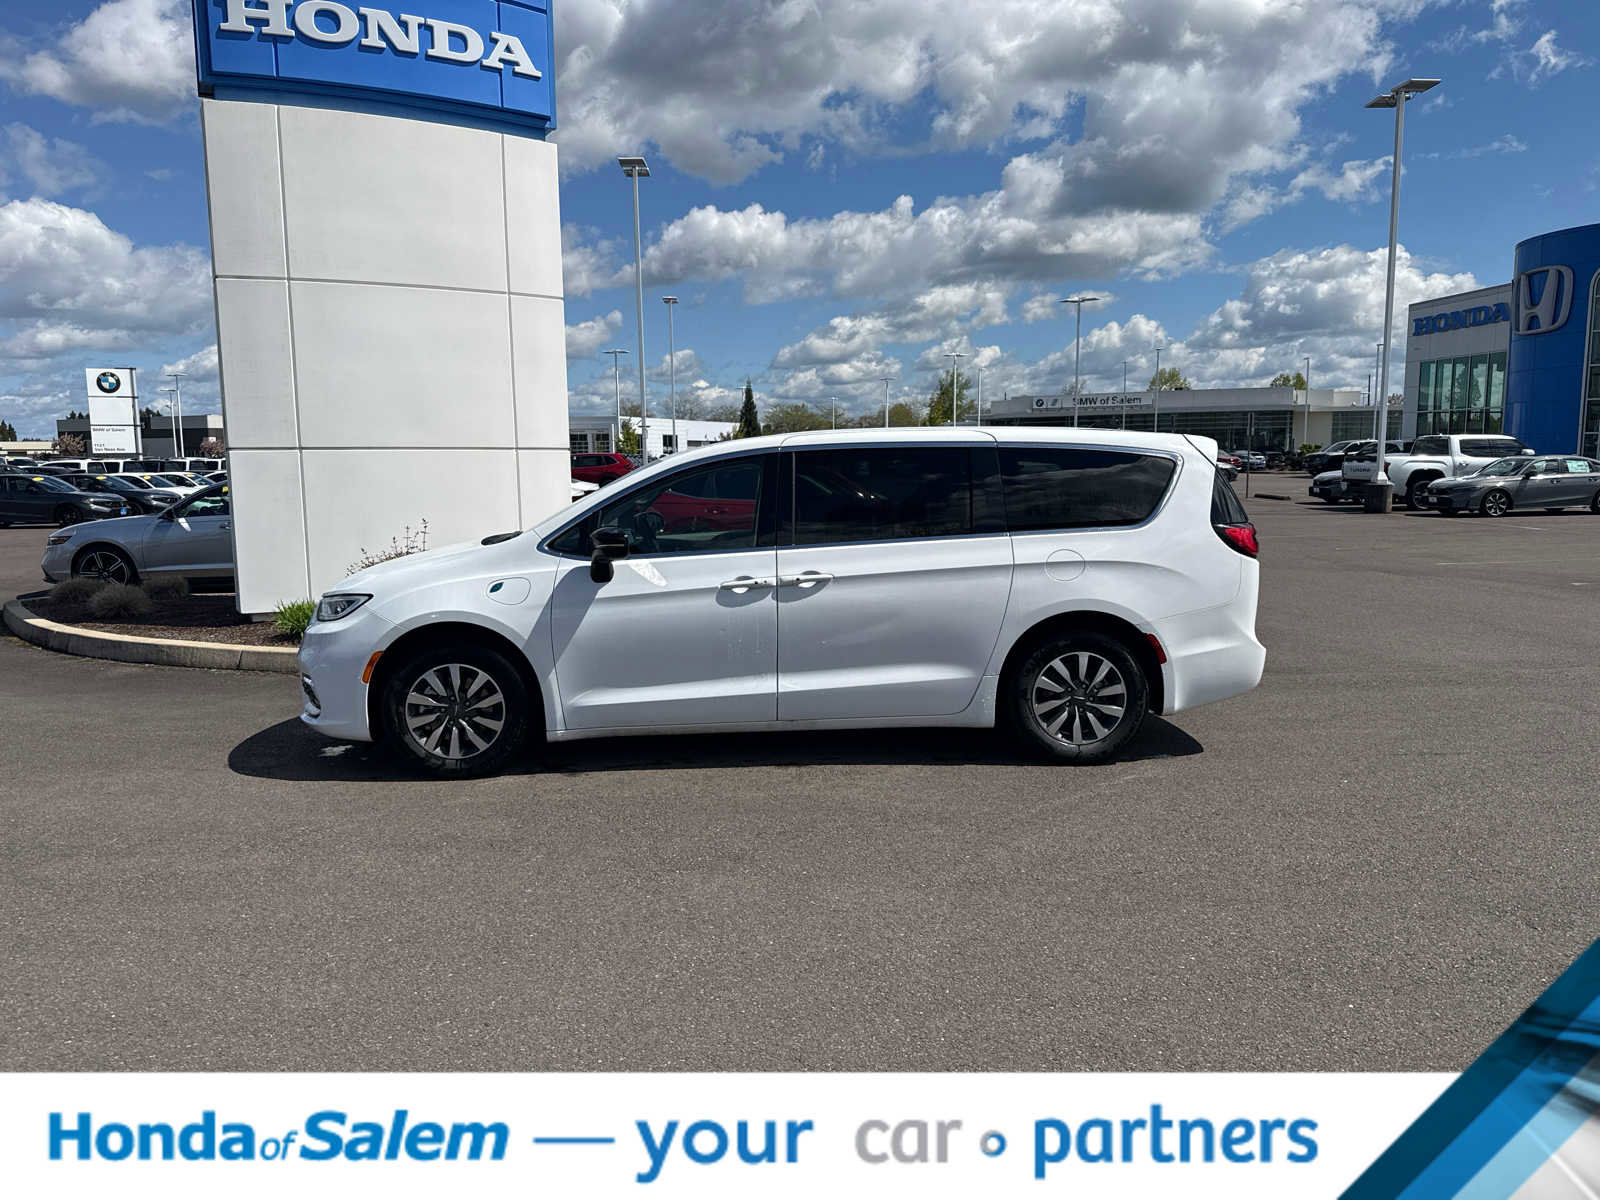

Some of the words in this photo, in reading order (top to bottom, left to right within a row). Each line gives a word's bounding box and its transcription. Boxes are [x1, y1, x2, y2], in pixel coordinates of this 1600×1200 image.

[219, 0, 542, 78] HONDA
[1412, 303, 1510, 336] HONDA
[1100, 396, 1110, 405] of
[1111, 395, 1142, 405] Salem
